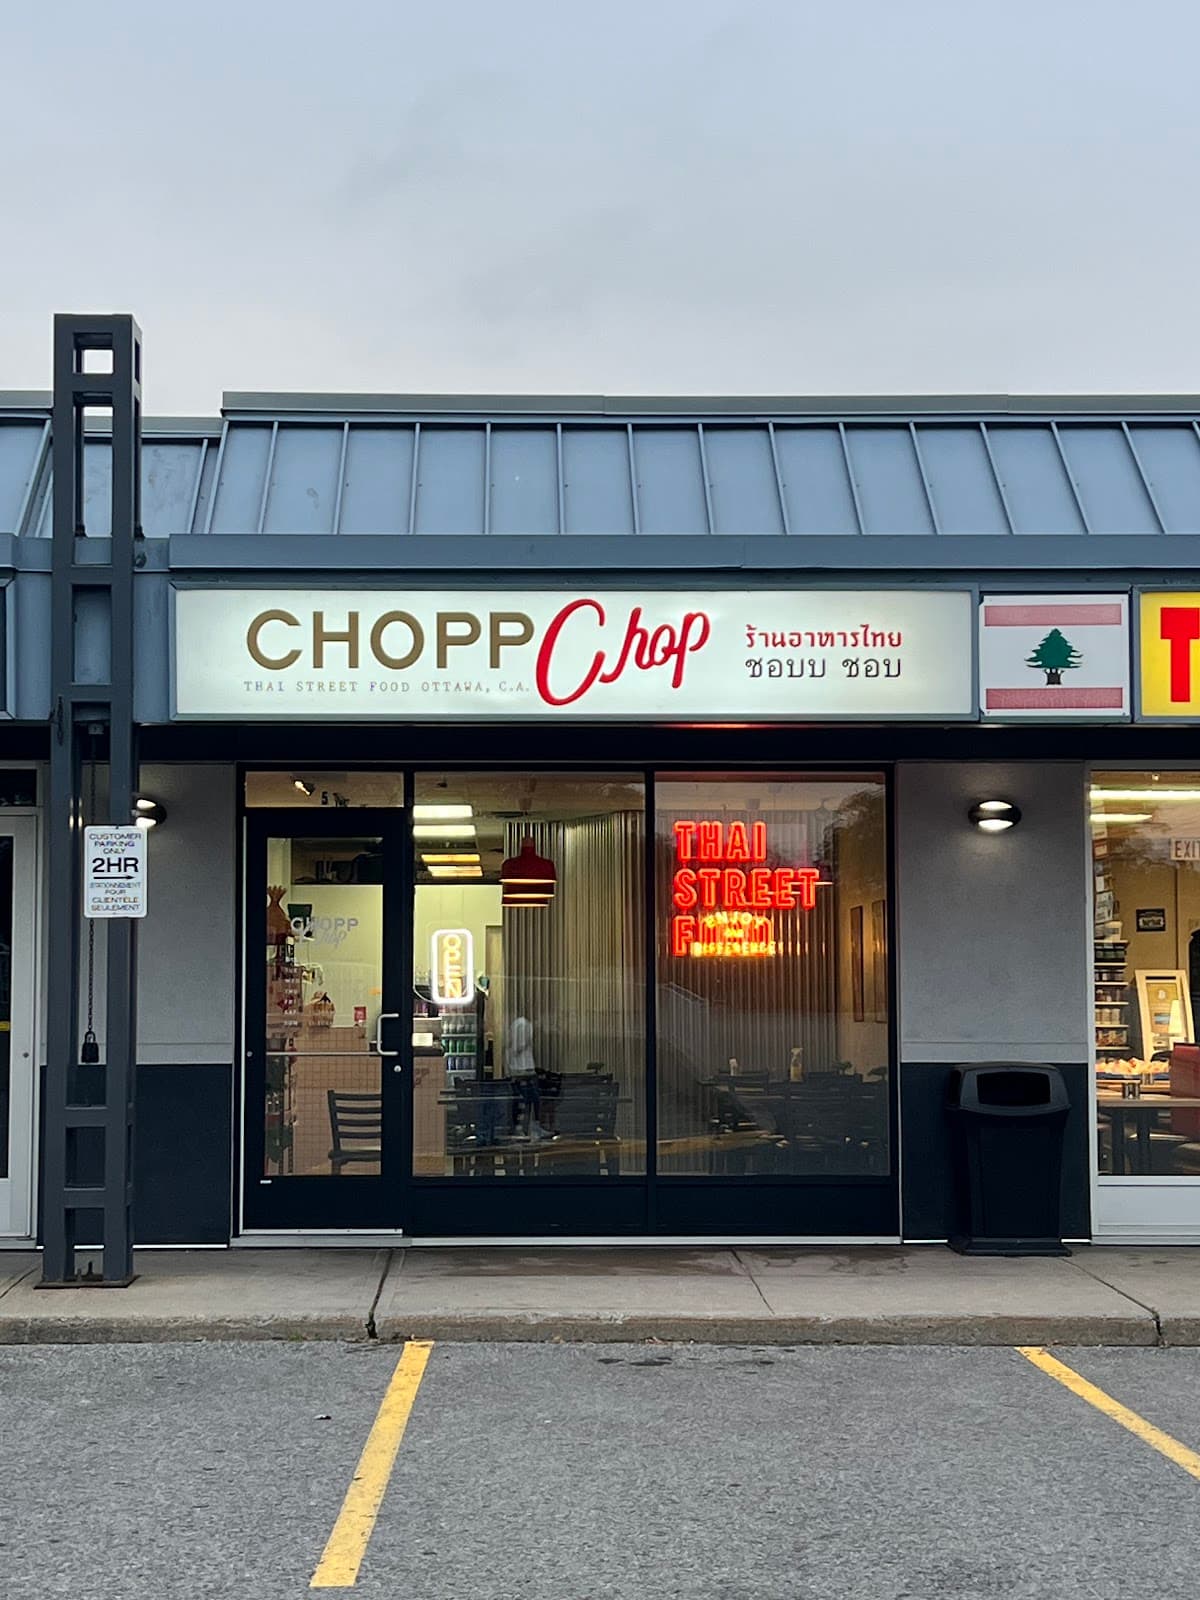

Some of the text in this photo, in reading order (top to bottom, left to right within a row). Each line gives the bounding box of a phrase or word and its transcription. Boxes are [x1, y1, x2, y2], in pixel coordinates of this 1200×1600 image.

[745, 623, 903, 648] ร้านอาหารไทย
[246, 598, 711, 706] CHOPP Chop
[745, 657, 902, 679] ชอบบ ชอบ
[244, 681, 285, 692] THAI
[296, 681, 358, 692] STREET
[369, 681, 410, 692] FOOD
[421, 681, 491, 693] OTTAWA,
[89, 833, 142, 841] CUSTOMER
[673, 820, 767, 863] THAI
[92, 857, 139, 873] 2HR
[672, 867, 820, 911] STREET
[443, 934, 463, 998] OPEN
